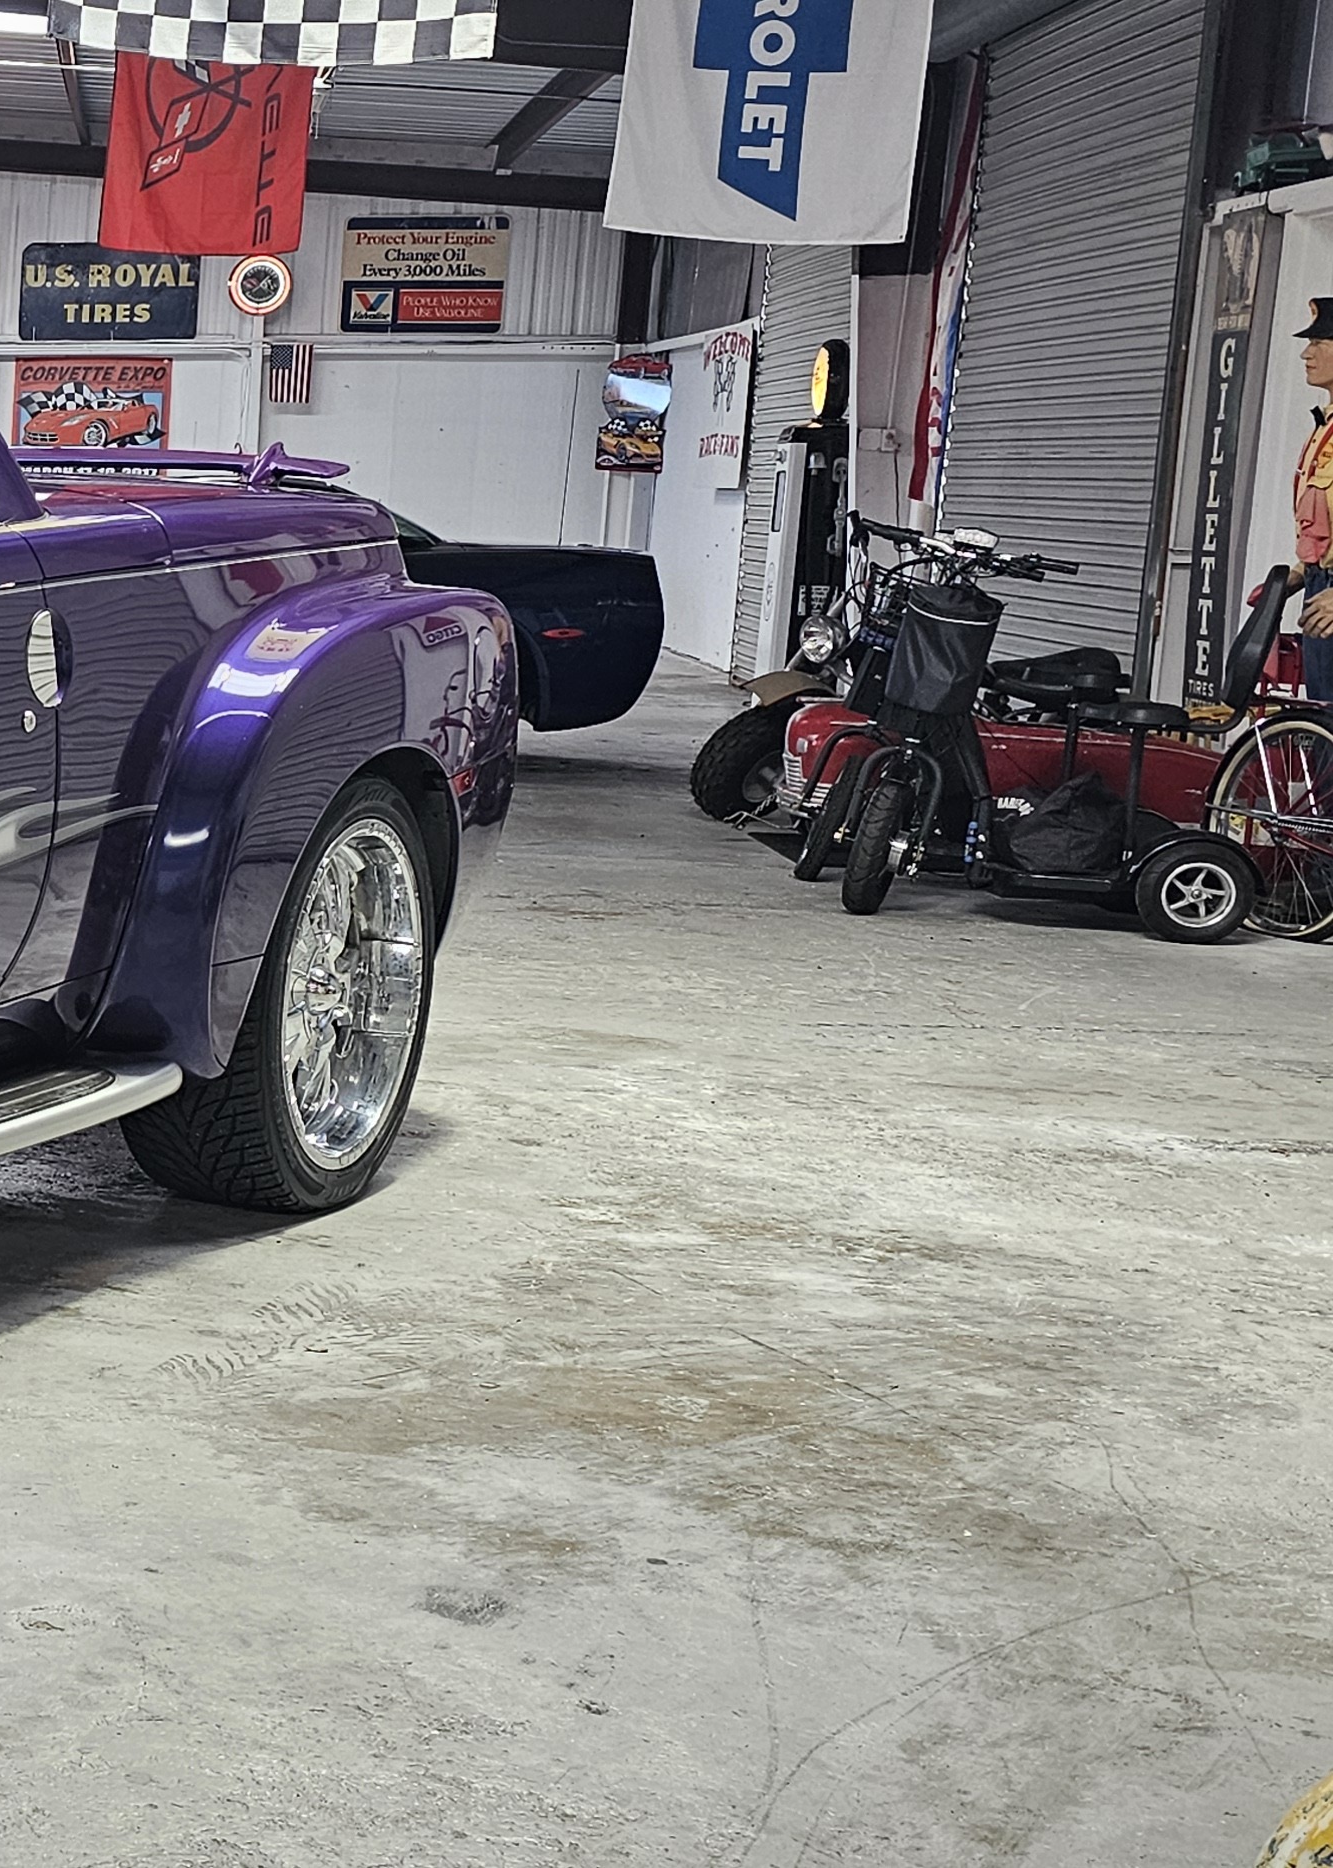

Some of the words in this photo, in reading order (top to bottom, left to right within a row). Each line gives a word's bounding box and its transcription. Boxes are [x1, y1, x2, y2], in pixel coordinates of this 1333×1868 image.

[355, 231, 407, 246] Protect
[409, 231, 441, 246] Your
[444, 231, 496, 247] Engine
[384, 248, 440, 263] Change
[442, 248, 466, 262] Oil
[24, 263, 81, 288] U.S.
[88, 263, 196, 288] ROYAL
[361, 264, 403, 279] Every
[403, 264, 444, 279] 3,000
[445, 264, 486, 277] Miles
[64, 303, 152, 323] TIRES
[352, 310, 391, 321] Valvoline
[703, 331, 751, 372] WELCOME
[20, 366, 113, 382] CORVETTE
[116, 366, 167, 382] EXPO
[1194, 337, 1237, 677] GILLETTE
[1188, 679, 1214, 697] TIRES
